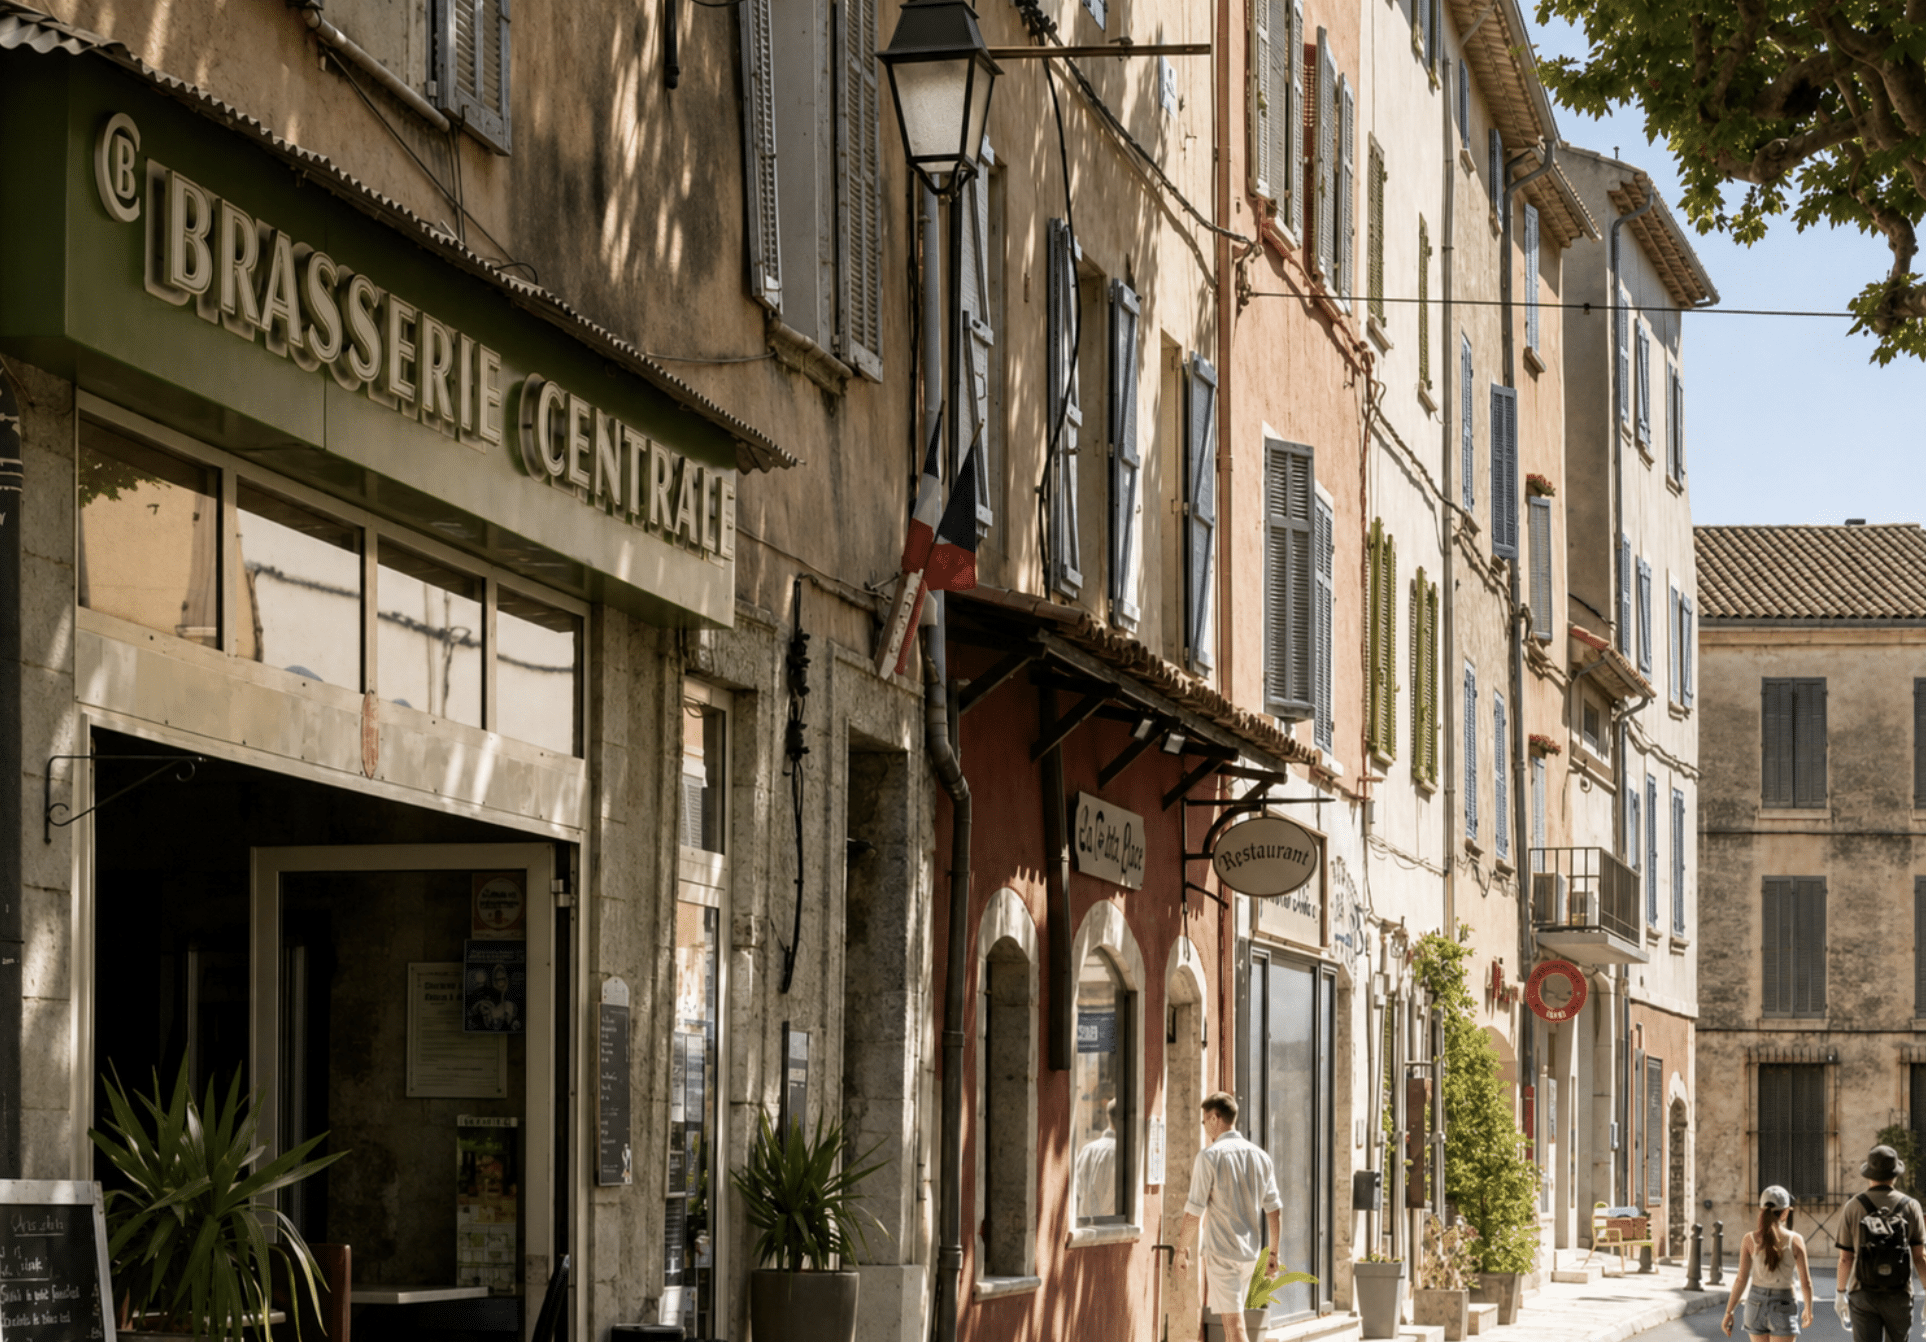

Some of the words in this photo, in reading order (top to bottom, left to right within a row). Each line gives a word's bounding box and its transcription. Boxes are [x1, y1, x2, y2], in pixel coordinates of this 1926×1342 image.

[163, 168, 503, 446] BRASSERIE
[535, 378, 736, 561] CENTRALE
[1218, 841, 1310, 872] Restaurant
